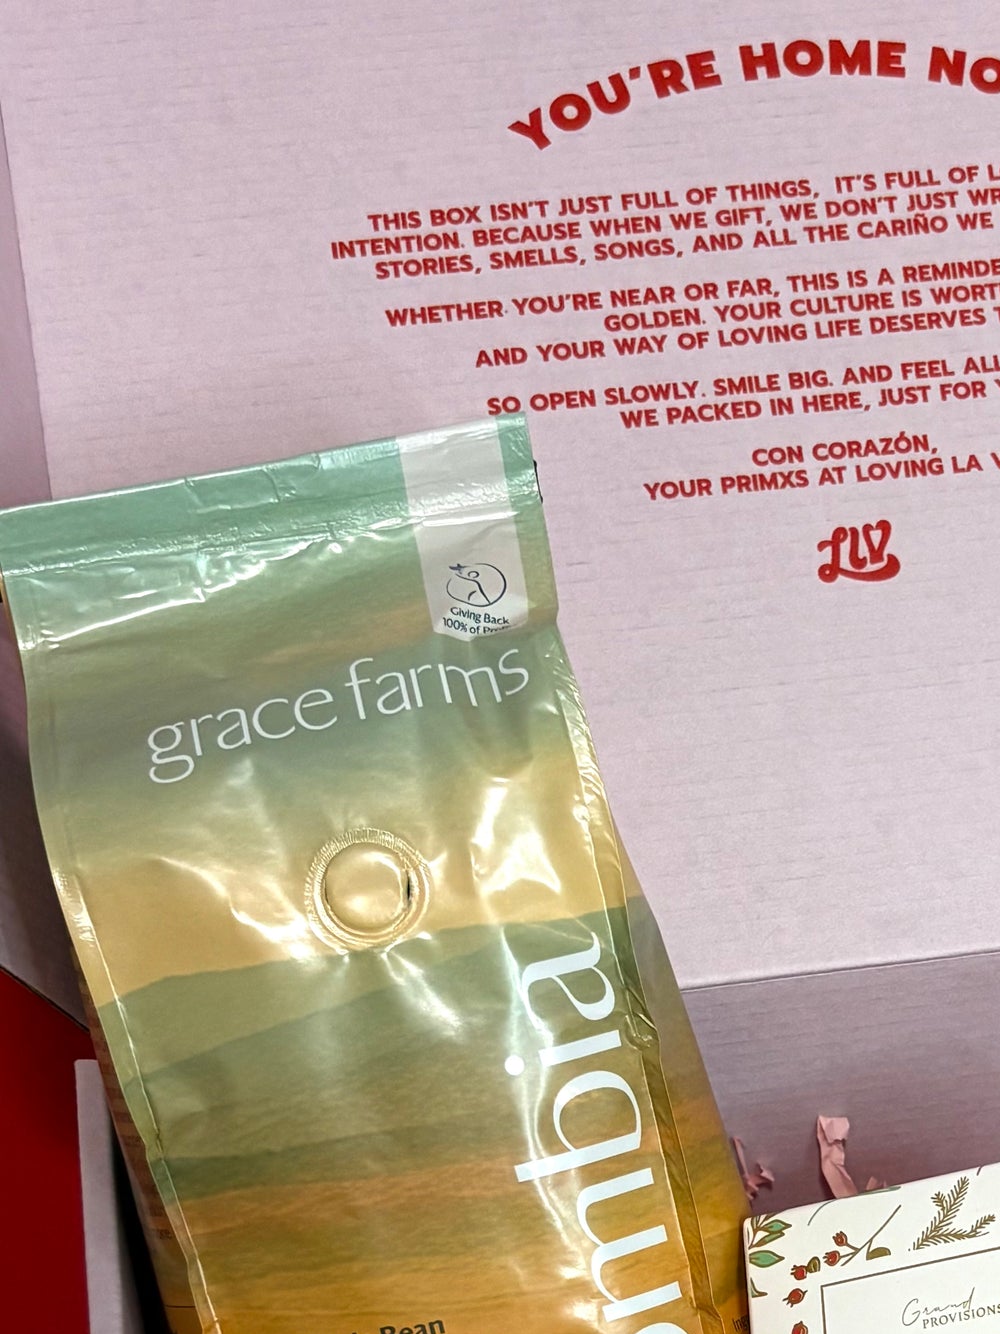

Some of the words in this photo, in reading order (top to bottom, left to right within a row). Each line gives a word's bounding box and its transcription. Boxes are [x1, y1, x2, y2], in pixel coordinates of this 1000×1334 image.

[508, 50, 721, 149] YOU'RE
[739, 39, 906, 81] HOME
[368, 211, 421, 231] THIS
[429, 206, 480, 226] BOX
[490, 200, 548, 222] ISN'T
[559, 195, 611, 216] JUST
[621, 190, 678, 211] FULL
[686, 187, 717, 205] OF
[726, 180, 817, 202] THINGS,
[835, 174, 876, 193] IT'S
[884, 170, 939, 190] FULL
[948, 165, 978, 184] OF
[331, 231, 465, 259] INTENTION.
[472, 222, 581, 247] BECAUSE
[590, 215, 661, 237] WHEN
[670, 211, 707, 230] WE
[715, 206, 771, 227] GIFT,
[780, 202, 816, 221] WE
[825, 196, 898, 219] DON'T
[907, 191, 959, 213] JUST
[375, 254, 480, 279] STORIES,
[489, 246, 584, 270] SMELLS,
[594, 238, 682, 261] SONGS,
[693, 232, 742, 252] AND
[753, 229, 795, 248] ALL
[803, 223, 849, 243] THE
[856, 213, 949, 240] CARIÑO
[957, 212, 992, 231] WE
[513, 292, 601, 315] YOU'RE
[610, 286, 675, 308] NEAR
[684, 282, 718, 301] OR
[726, 278, 779, 298] FAR,
[787, 272, 839, 292] THIS
[847, 270, 867, 288] IS
[877, 268, 894, 285] A
[604, 308, 706, 332] GOLDEN.
[714, 301, 780, 322] YOUR
[790, 291, 893, 316] CULTURE
[902, 289, 922, 307] IS
[476, 347, 527, 367] AND
[537, 340, 604, 362] YOUR
[613, 335, 666, 355] WAY
[677, 331, 708, 350] OF
[718, 323, 807, 347] LOVING
[815, 319, 862, 339] LIFE
[869, 308, 986, 334] DESERVES
[487, 396, 521, 415] SO
[530, 389, 596, 411] OPEN
[604, 382, 706, 405] SLOWLY.
[713, 374, 780, 396] SMILE
[788, 370, 833, 390] BIG.
[843, 365, 892, 384] AND
[900, 360, 953, 380] FEEL
[620, 409, 658, 428] WE
[666, 400, 762, 424] PACKED
[770, 398, 794, 416] IN
[802, 392, 870, 413] HERE,
[880, 385, 930, 406] JUST
[939, 381, 986, 400] FOR
[752, 446, 803, 467] CON
[812, 432, 936, 461] CORAZÓN,
[644, 478, 712, 500] YOUR
[720, 470, 809, 494] PRIMXS
[819, 466, 845, 485] AT
[855, 457, 944, 482] LOVING
[952, 455, 982, 473] LA
[443, 617, 467, 632] 100%
[470, 626, 480, 634] of
[450, 607, 481, 623] Giving
[484, 613, 510, 625] Back
[147, 689, 338, 784] grace
[345, 649, 530, 720] farms
[901, 1286, 975, 1326] Grand
